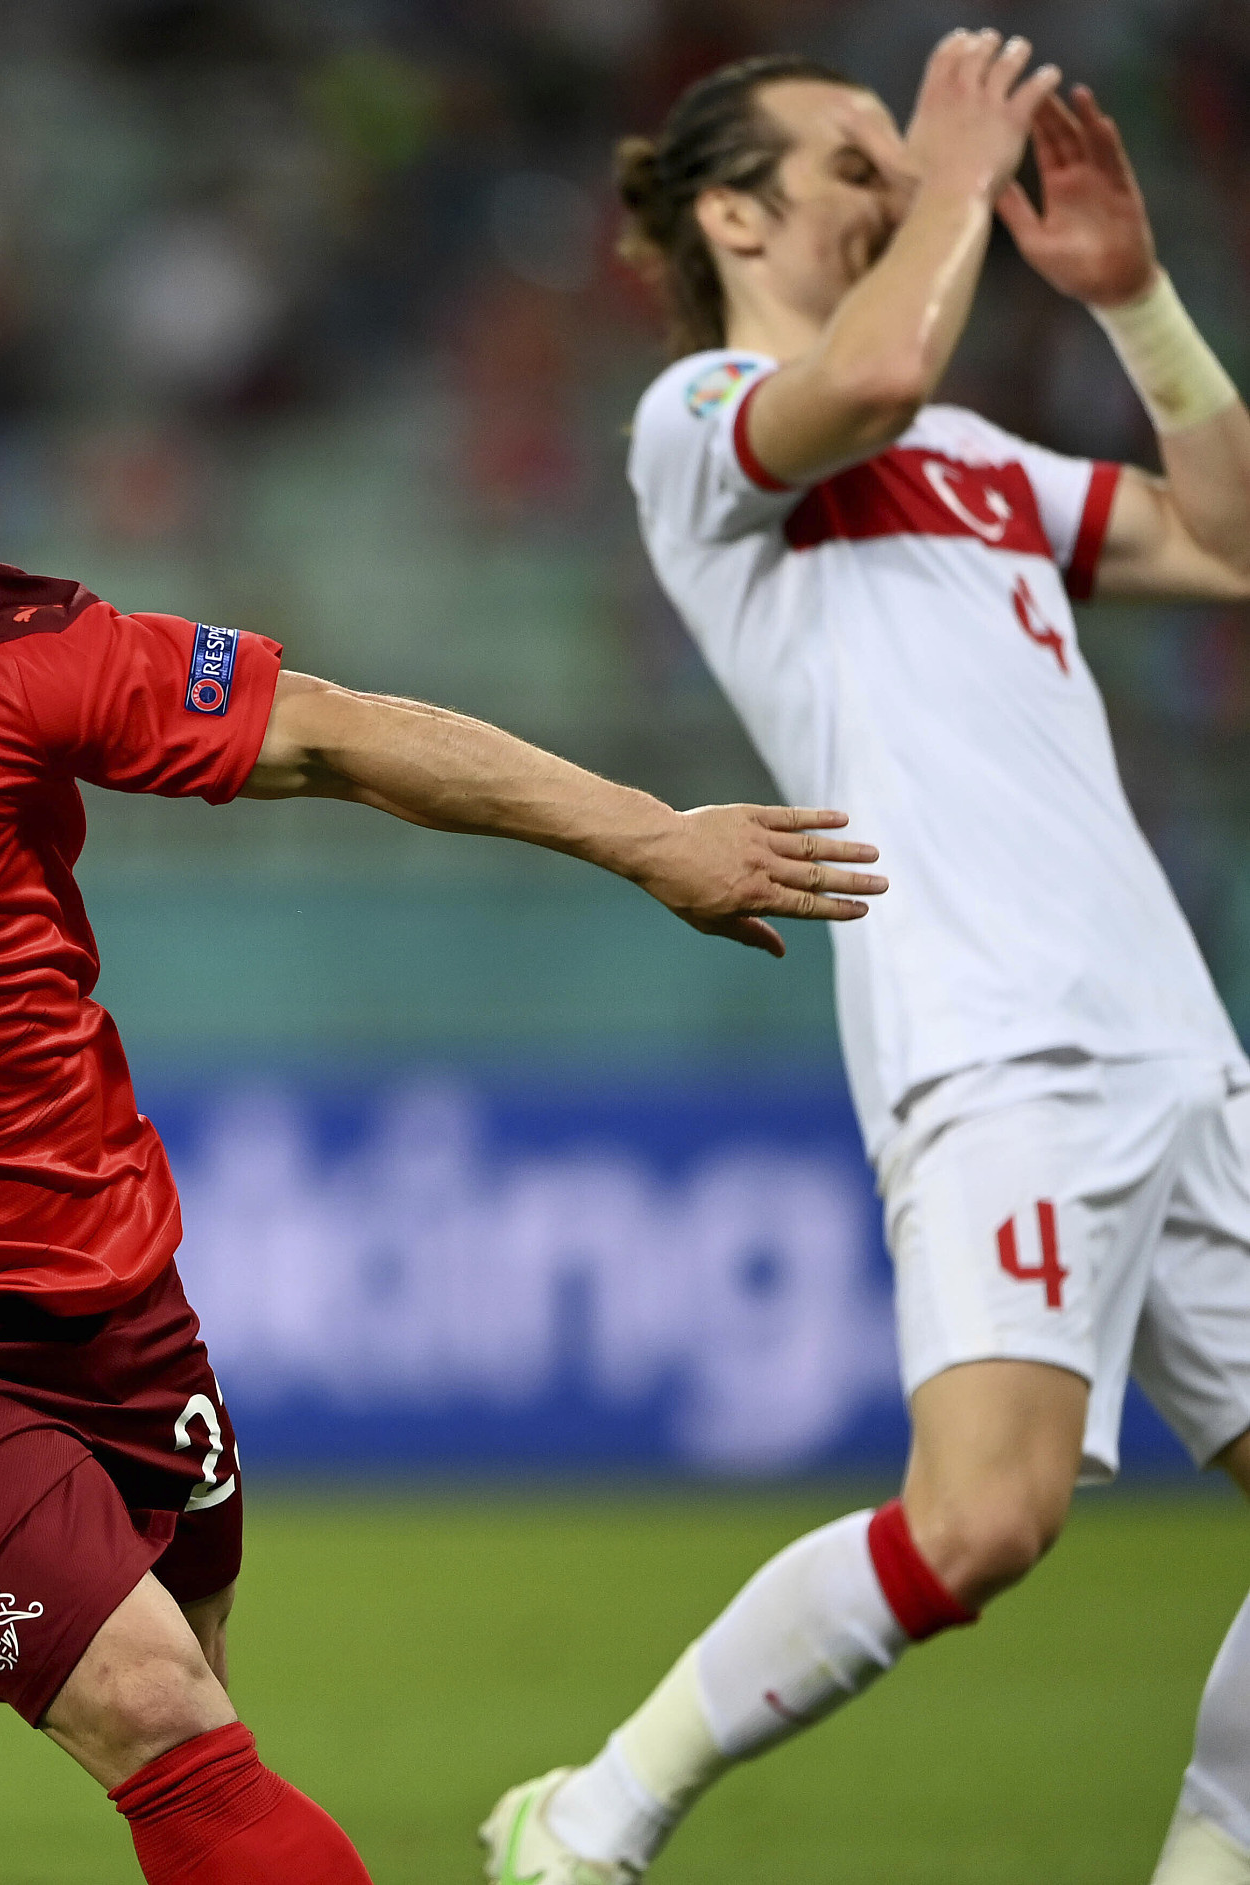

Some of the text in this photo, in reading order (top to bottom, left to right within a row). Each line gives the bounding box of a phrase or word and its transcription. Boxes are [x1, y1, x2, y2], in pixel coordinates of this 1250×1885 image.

[1012, 574, 1071, 677] 4
[996, 1198, 1068, 1309] 4
[174, 1373, 241, 1512] 2
